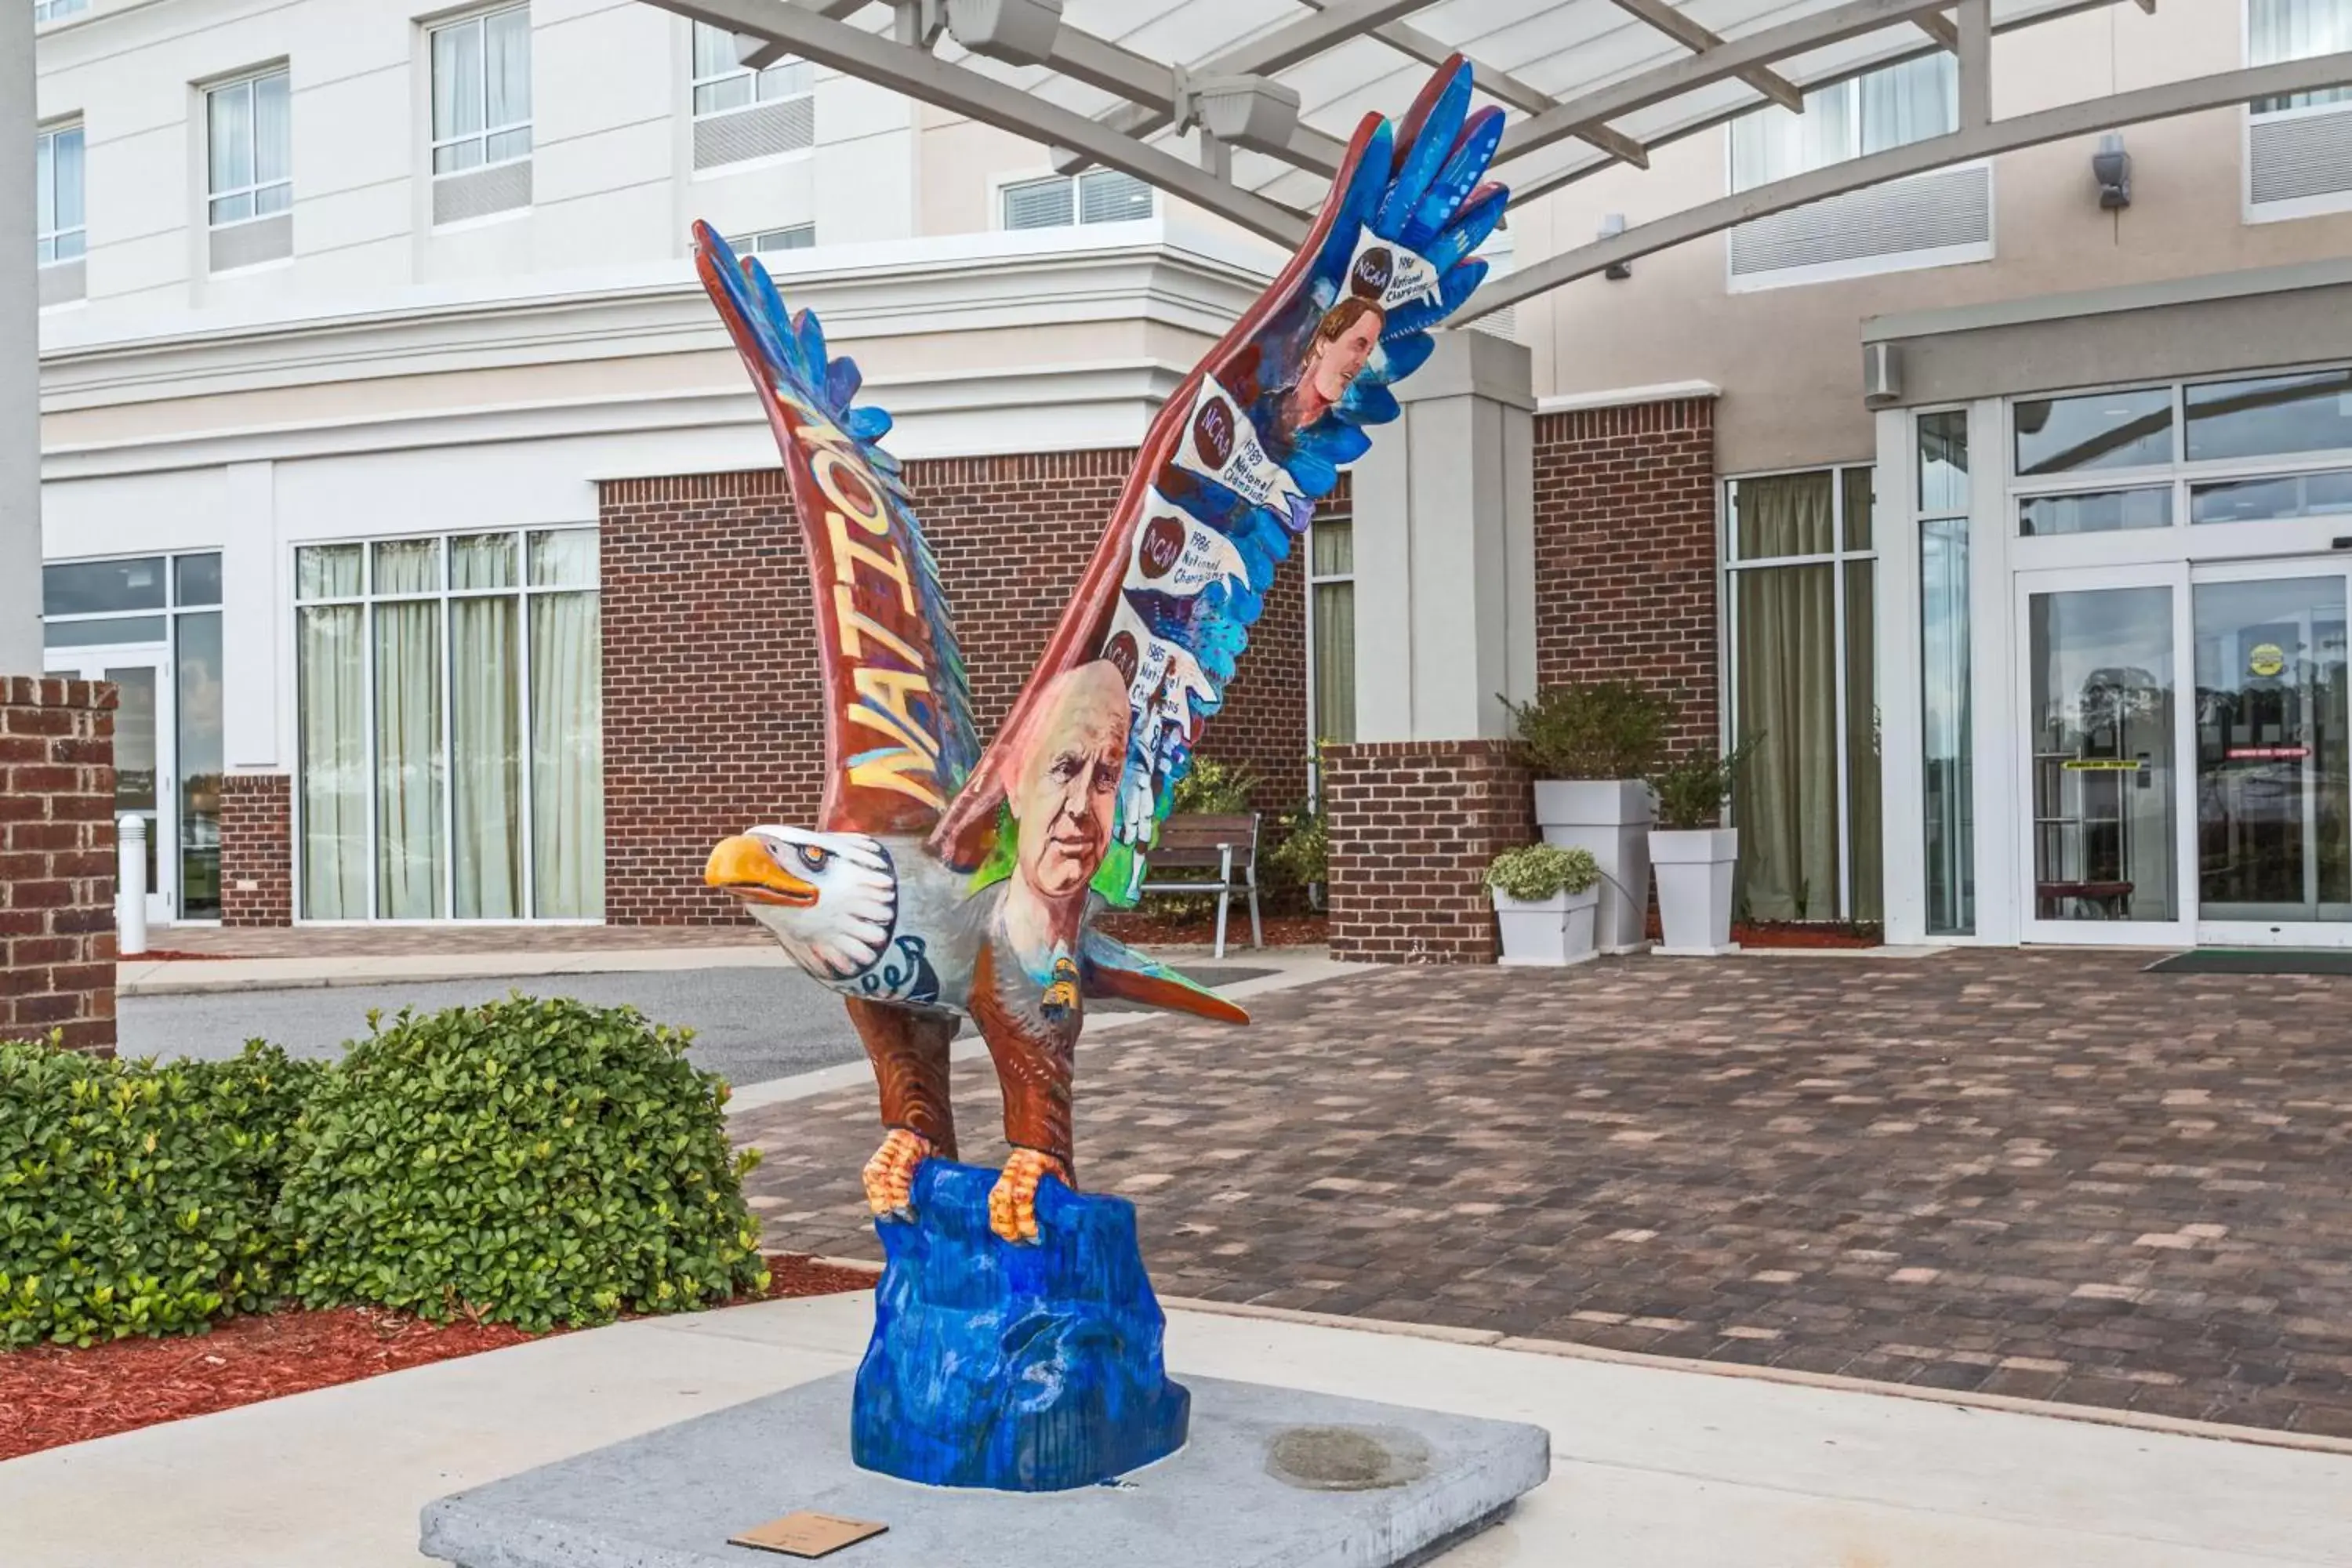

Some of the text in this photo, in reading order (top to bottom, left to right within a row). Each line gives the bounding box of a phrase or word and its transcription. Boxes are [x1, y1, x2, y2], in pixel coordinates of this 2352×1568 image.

[1355, 259, 1386, 289] NCAA
[1202, 408, 1229, 458] NCAA
[1232, 456, 1275, 492] National
[1144, 528, 1178, 569] NCAA
[1181, 550, 1221, 572] National
[772, 381, 947, 812] NATION
